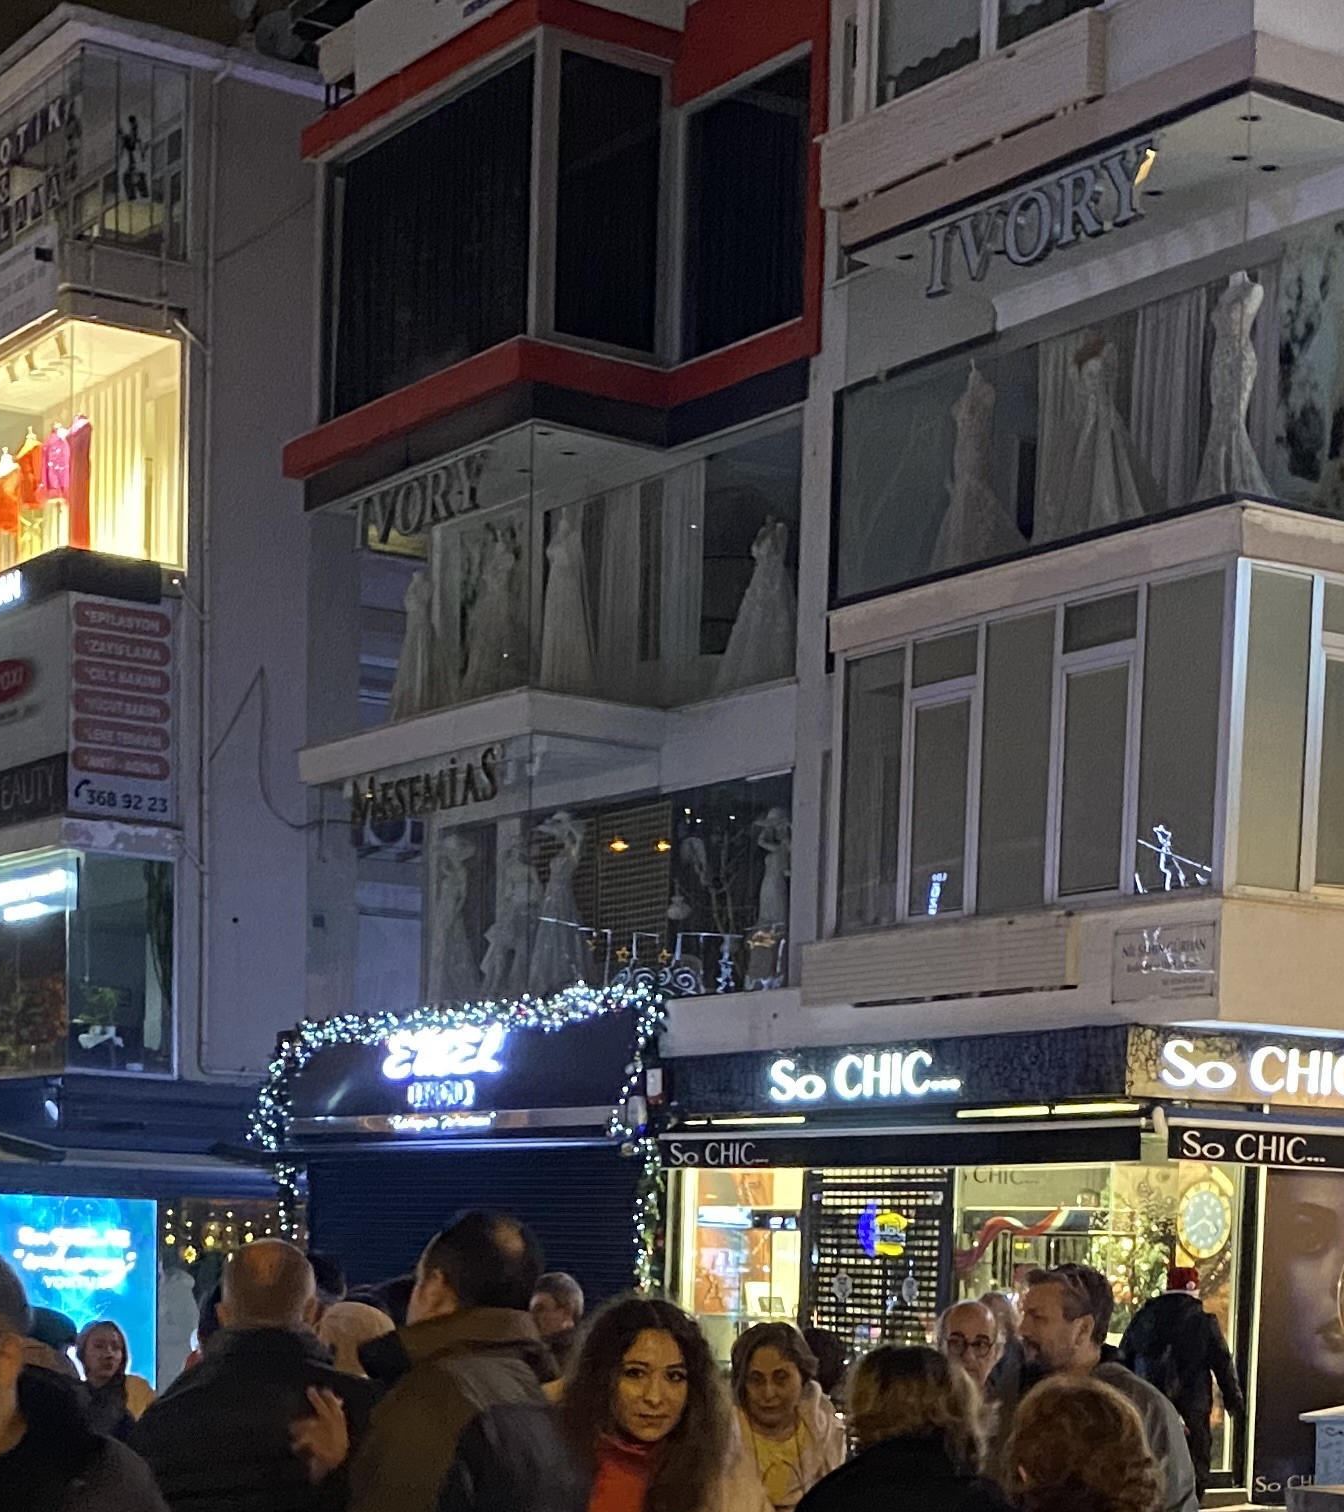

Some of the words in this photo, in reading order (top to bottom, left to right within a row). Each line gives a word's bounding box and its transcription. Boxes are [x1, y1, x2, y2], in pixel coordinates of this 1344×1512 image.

[925, 138, 1156, 298] IVORY
[357, 453, 490, 549] IVORY
[85, 788, 117, 808] 368
[121, 793, 144, 811] 92
[147, 796, 168, 814] 23
[769, 1059, 827, 1101] So
[834, 1050, 962, 1099] CHIC...
[1160, 1039, 1237, 1089] So
[670, 1142, 699, 1166] So
[1182, 1130, 1225, 1159] So
[1235, 1133, 1326, 1163] CHIC...
[1256, 1476, 1282, 1493] So
[1287, 1475, 1316, 1489] CH
